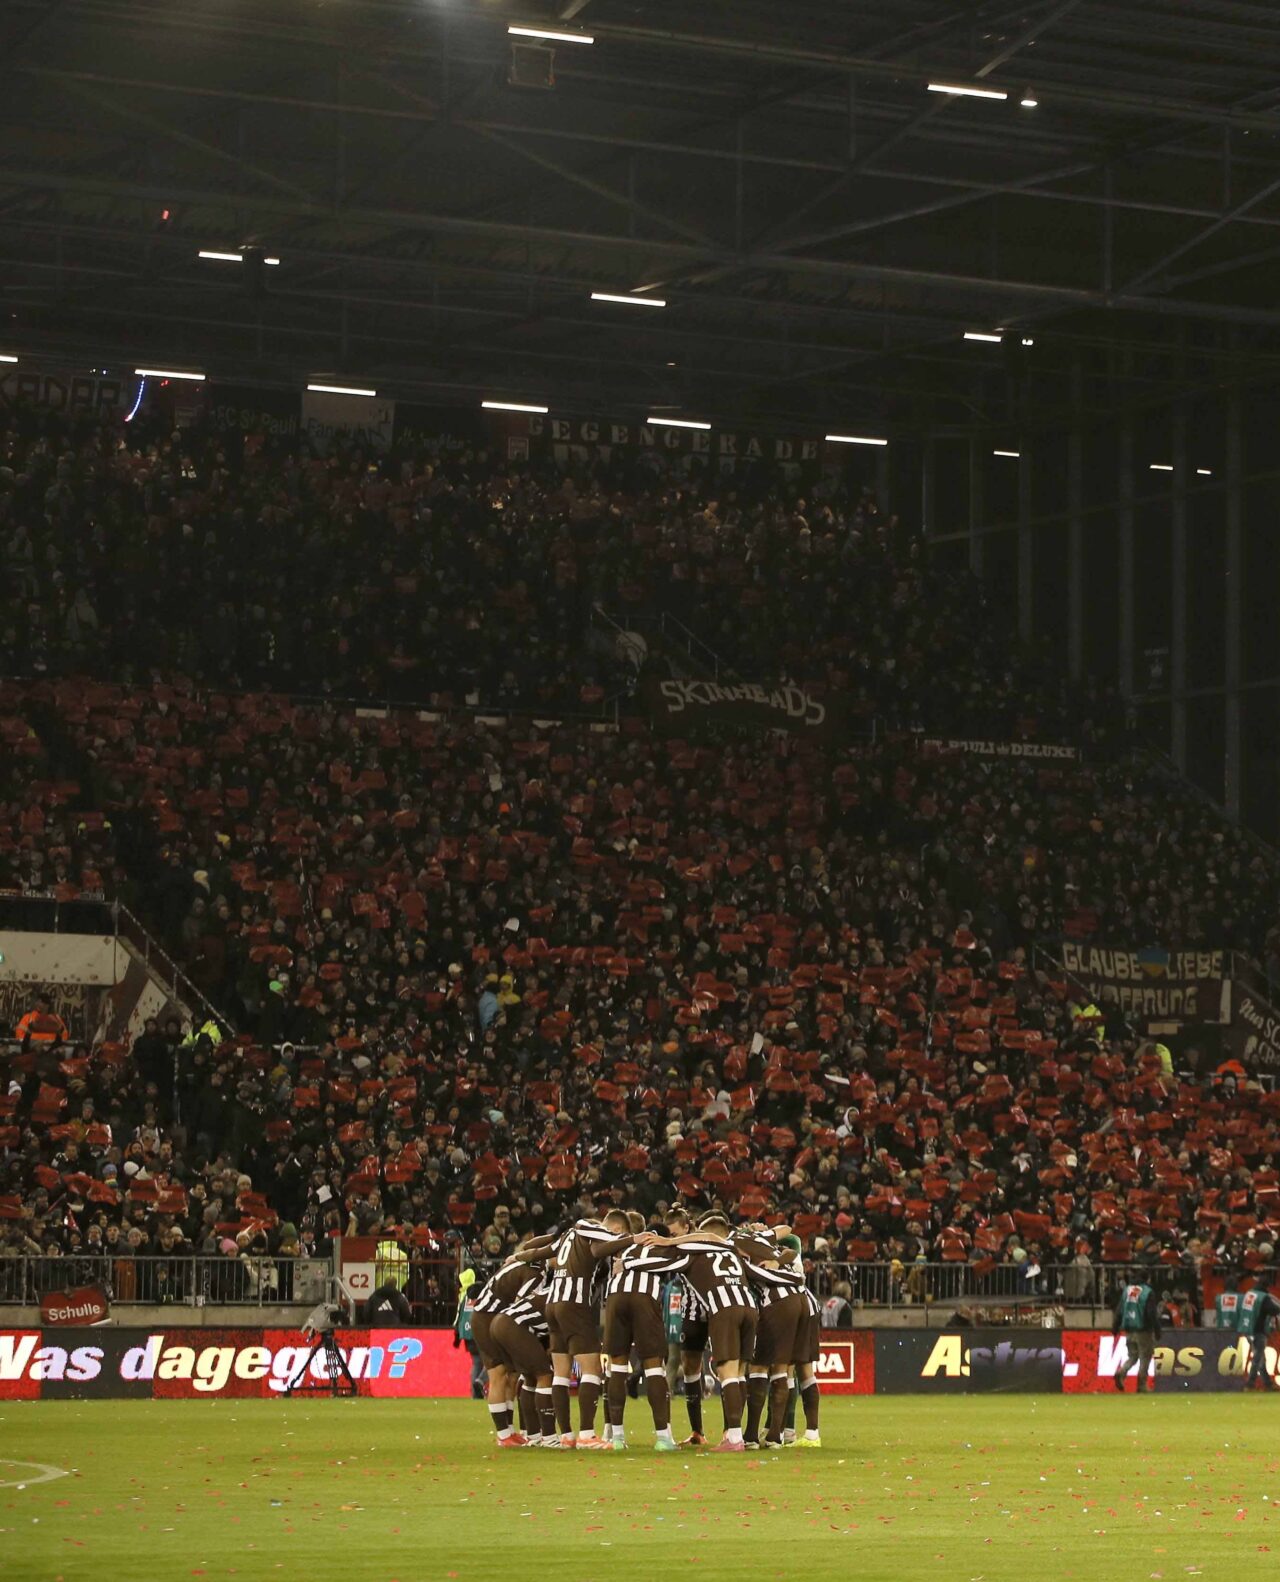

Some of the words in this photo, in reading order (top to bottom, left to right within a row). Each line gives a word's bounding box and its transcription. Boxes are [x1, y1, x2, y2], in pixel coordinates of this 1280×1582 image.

[659, 679, 827, 727] SKINHEADS
[1062, 942, 1143, 981] GLAUBE
[1165, 949, 1223, 980] LIEBE
[556, 1230, 576, 1267] 6
[705, 1250, 743, 1277] 23
[349, 1273, 371, 1290] C2
[48, 1302, 101, 1322] Schulle
